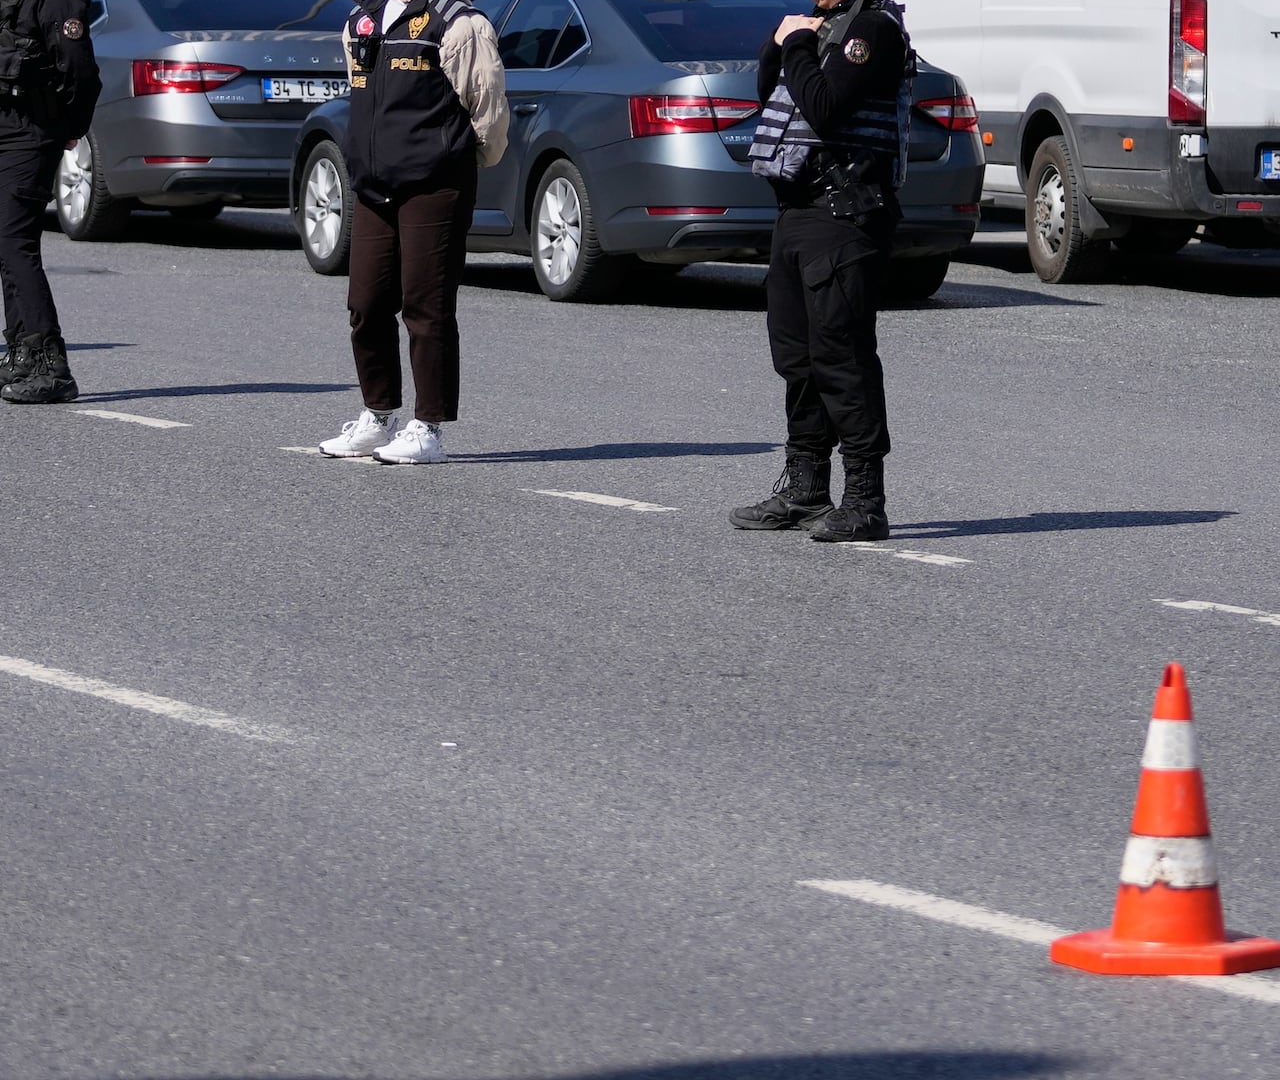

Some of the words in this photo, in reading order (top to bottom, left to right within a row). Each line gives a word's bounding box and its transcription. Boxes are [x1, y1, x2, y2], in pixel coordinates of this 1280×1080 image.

[390, 56, 431, 71] POLİS
[273, 80, 290, 97] 34
[298, 80, 315, 97] TC
[321, 80, 349, 97] 392
